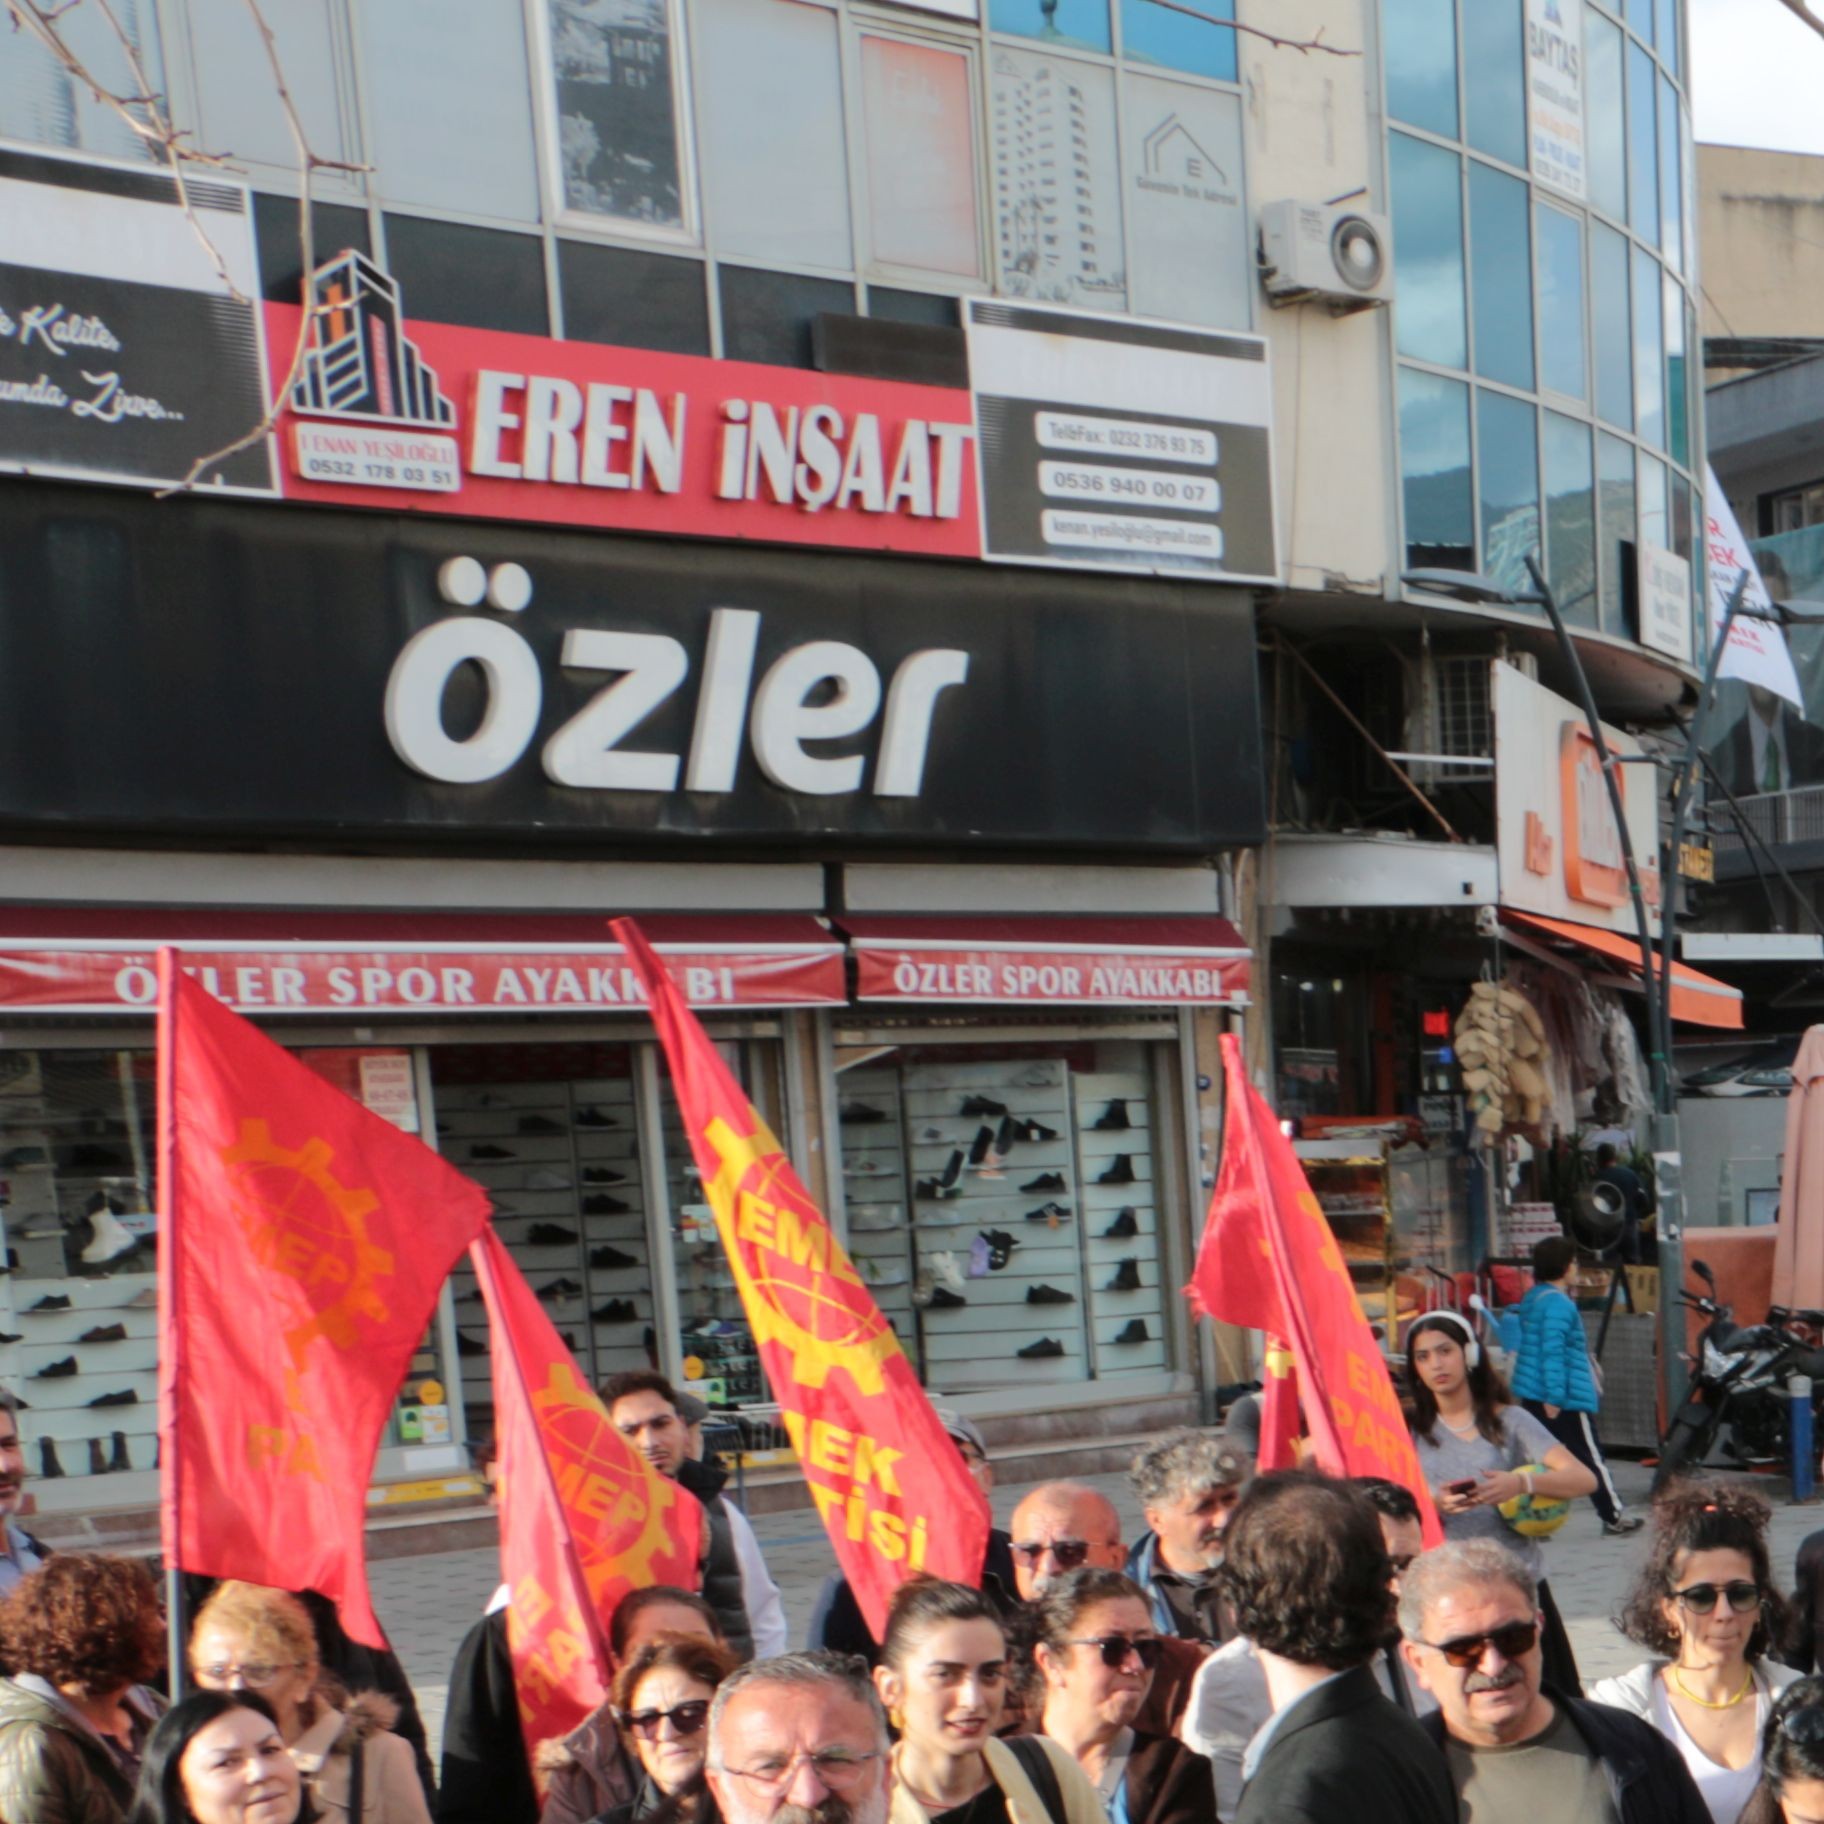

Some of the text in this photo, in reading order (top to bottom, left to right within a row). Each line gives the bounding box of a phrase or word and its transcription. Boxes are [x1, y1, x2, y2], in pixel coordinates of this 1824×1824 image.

[467, 369, 686, 493] EREN
[1109, 428, 1141, 449] 0232
[1145, 433, 1167, 450] 376
[308, 457, 453, 486] 0532 178 03 51
[1053, 471, 1206, 501] 0536 940 00 07
[384, 556, 970, 797] Özler
[115, 958, 734, 1004] ÖLER SPOR AYAKKBI
[893, 954, 1223, 999] ÖZLER SPOR AYAKKABI
